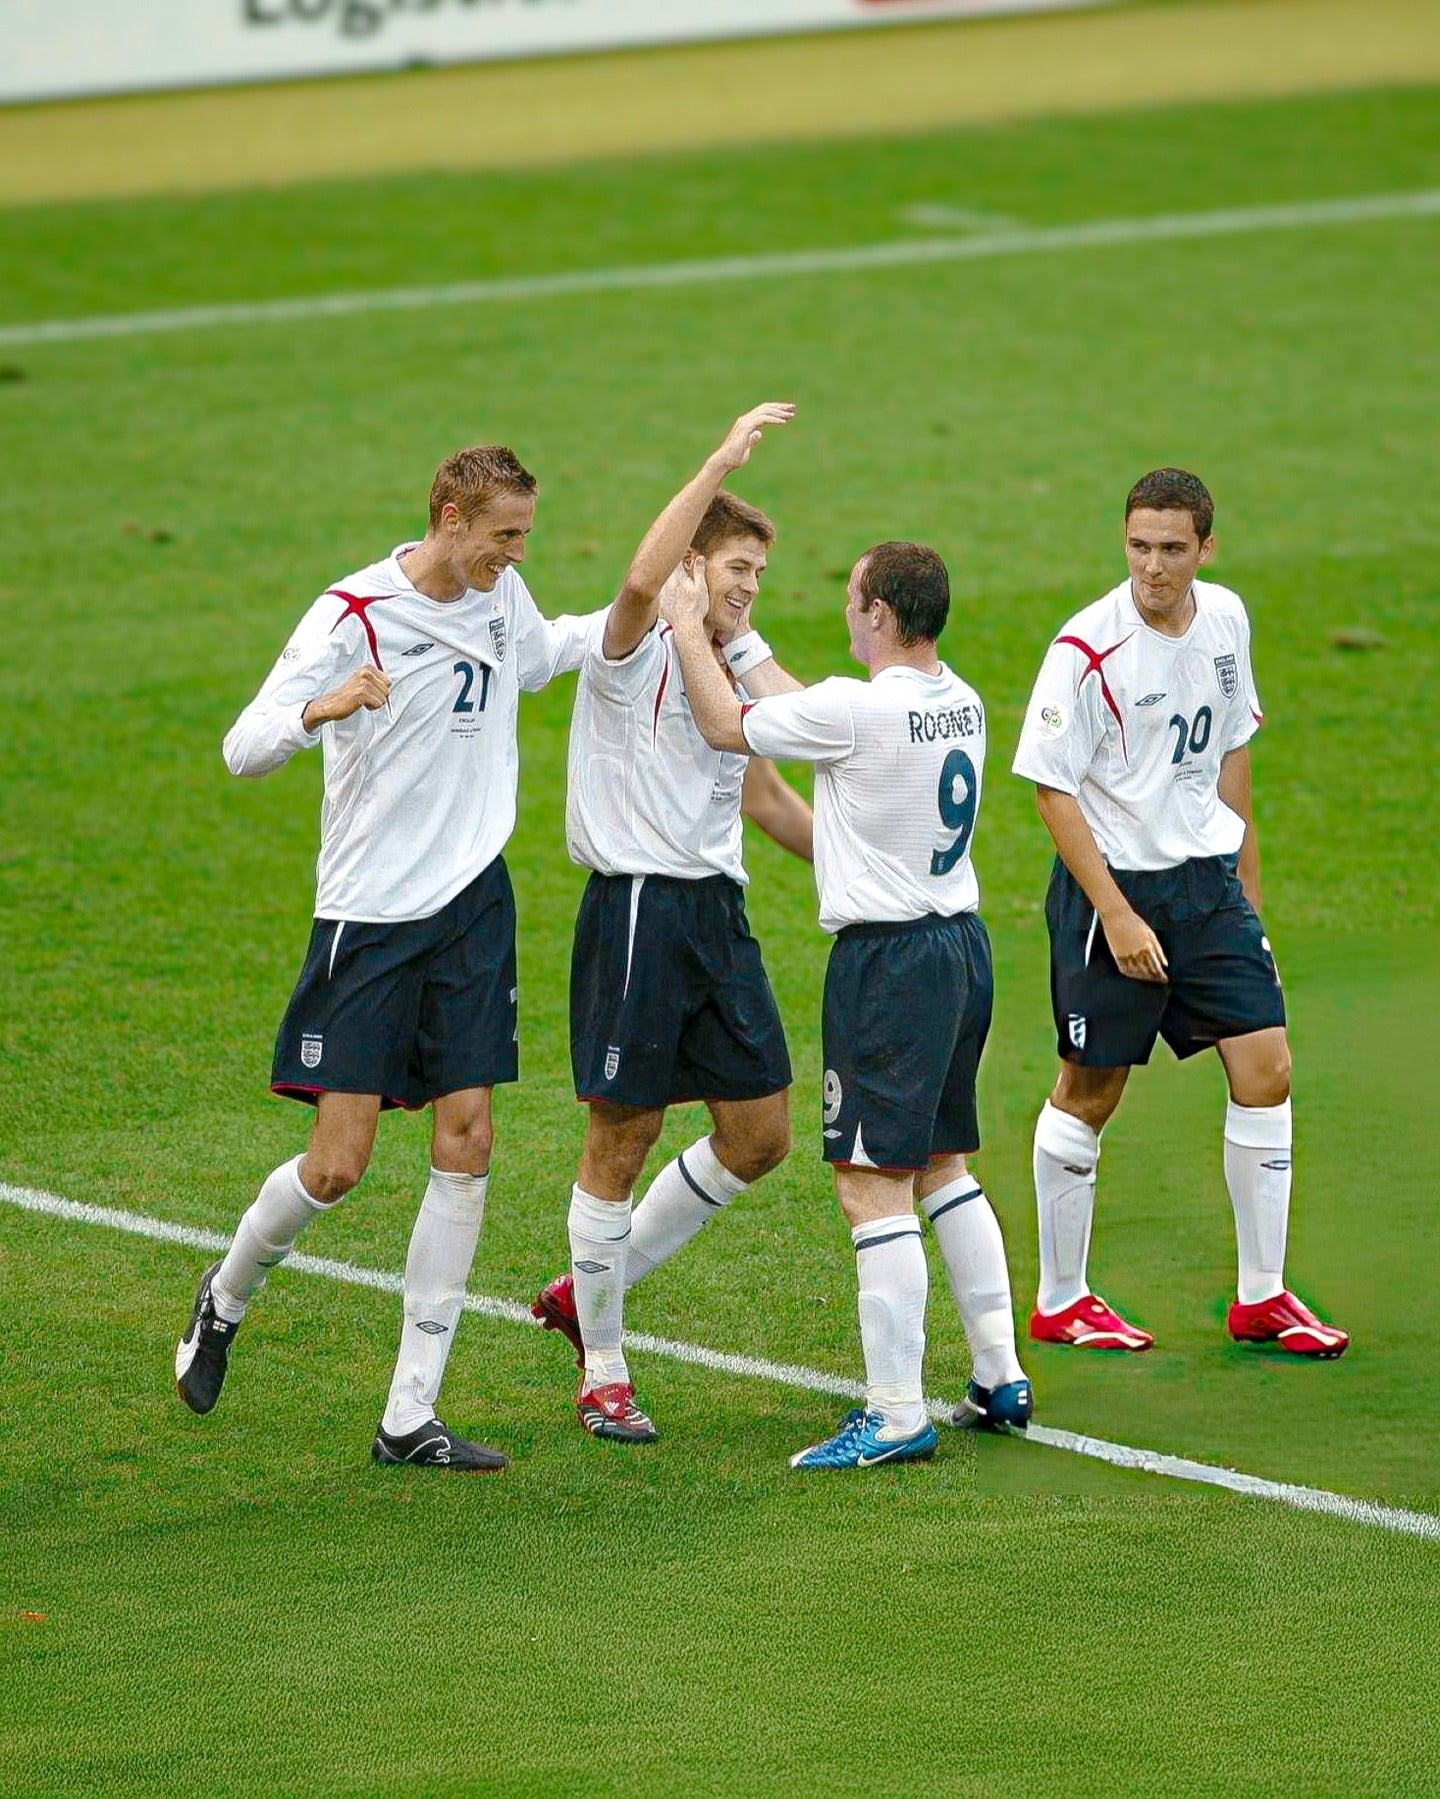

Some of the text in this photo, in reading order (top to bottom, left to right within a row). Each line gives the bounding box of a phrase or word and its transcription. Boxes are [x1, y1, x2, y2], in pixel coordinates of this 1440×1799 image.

[452, 661, 493, 713] 21
[909, 704, 983, 743] ROONEY
[1169, 705, 1212, 764] 20
[930, 749, 976, 876] 9
[823, 1069, 843, 1124] 9
